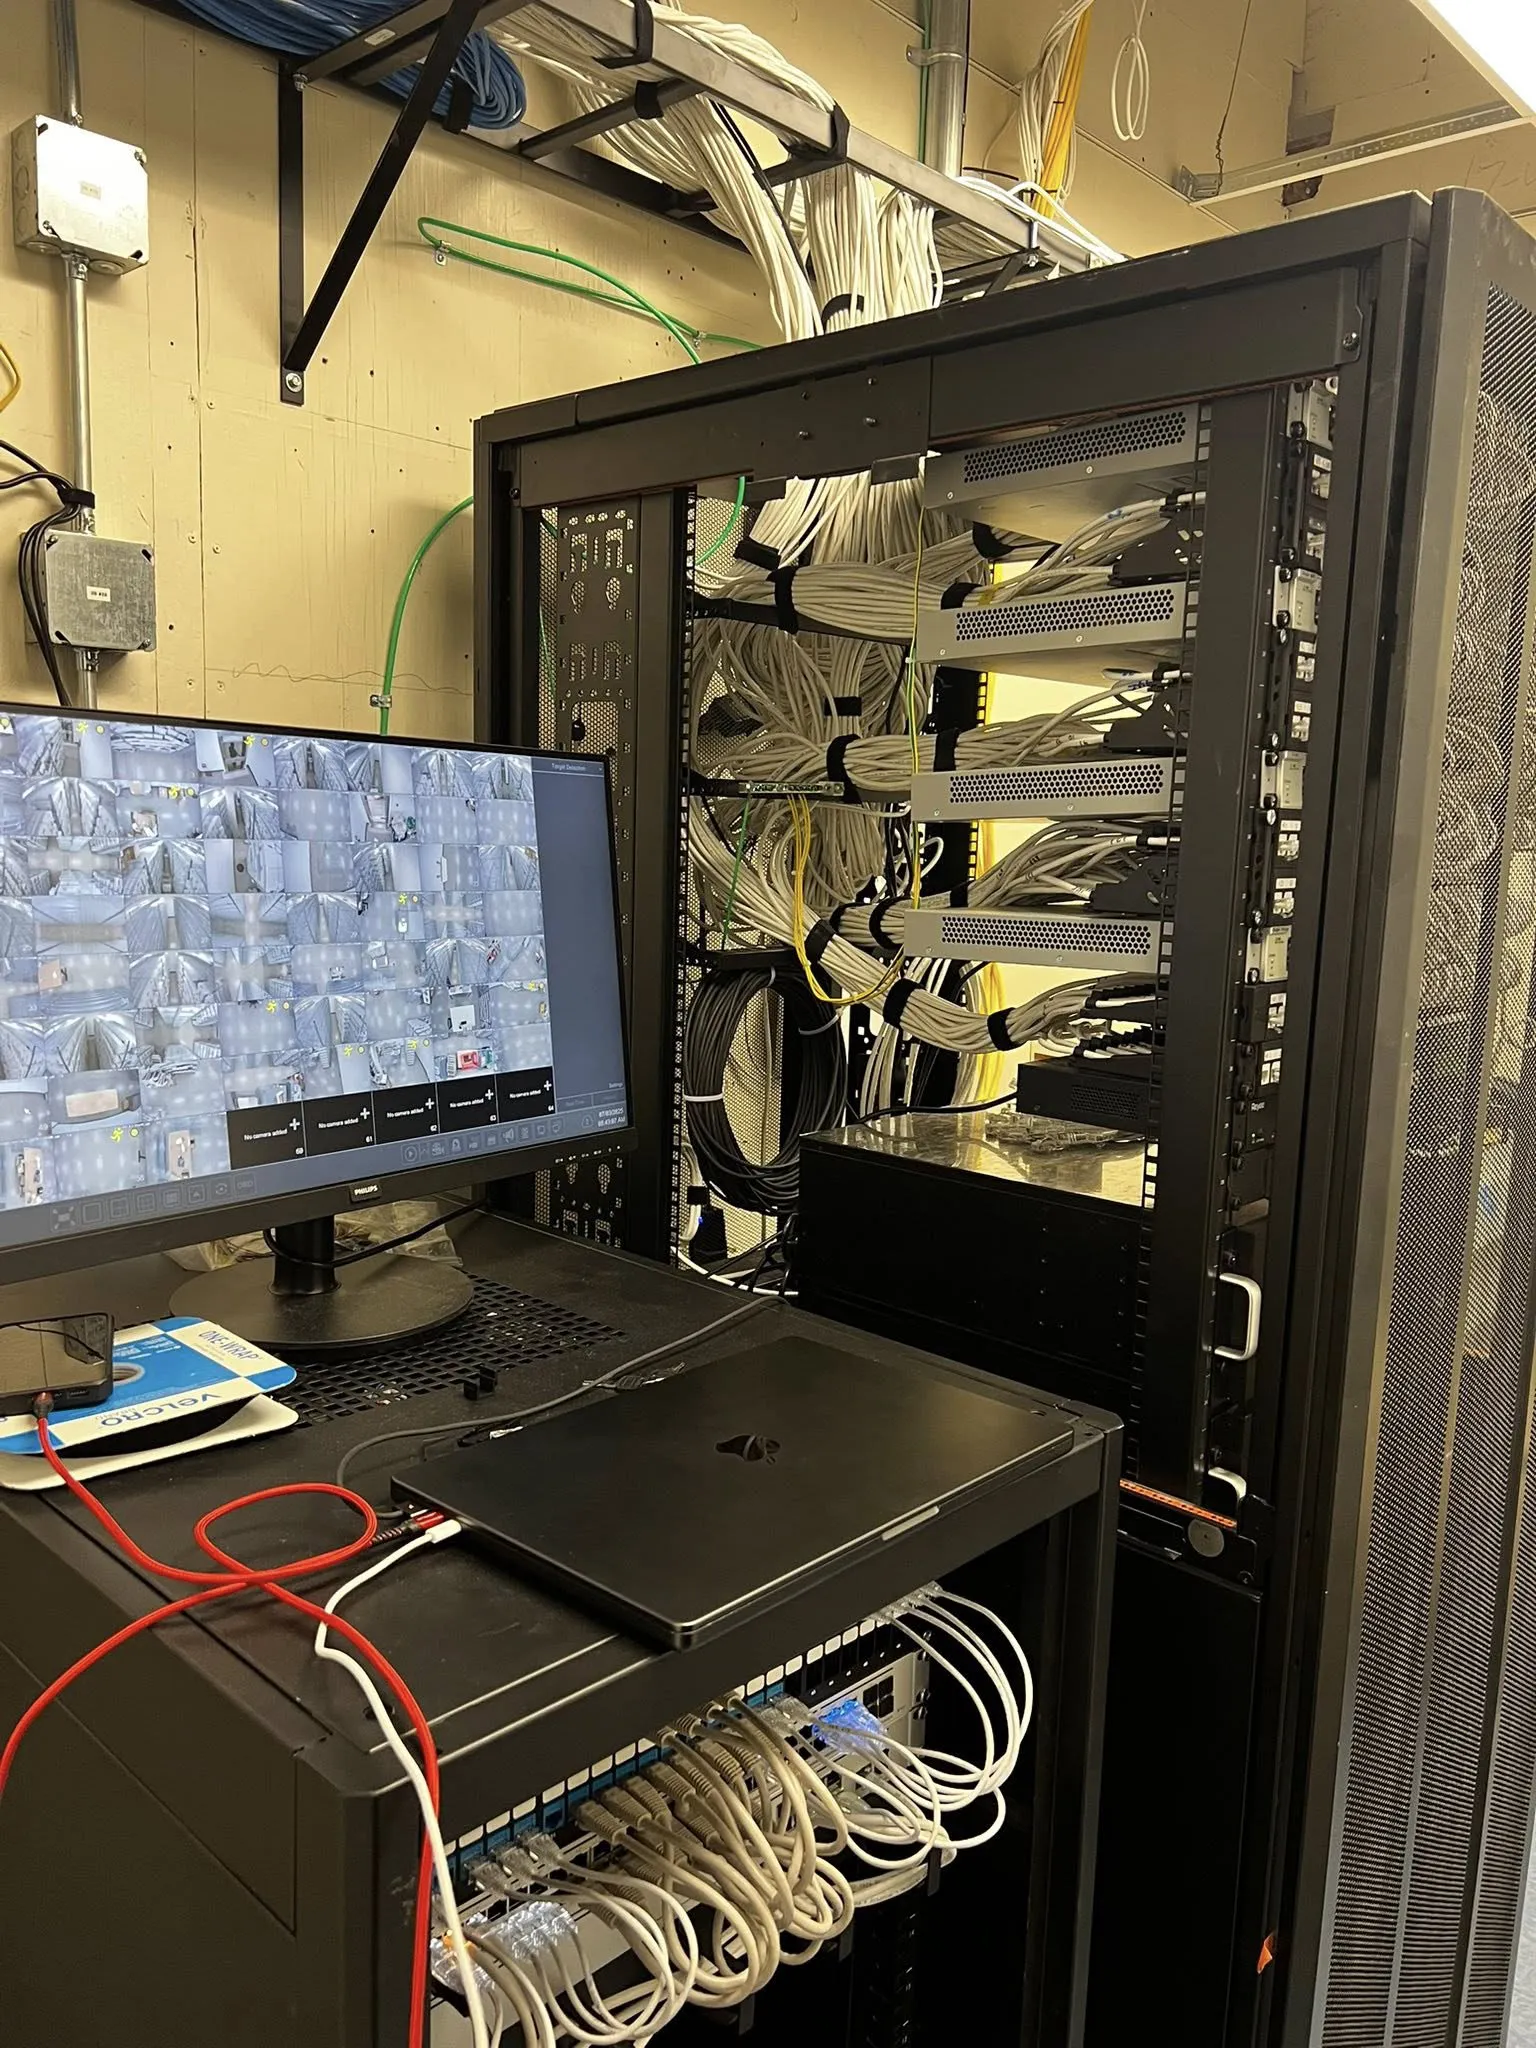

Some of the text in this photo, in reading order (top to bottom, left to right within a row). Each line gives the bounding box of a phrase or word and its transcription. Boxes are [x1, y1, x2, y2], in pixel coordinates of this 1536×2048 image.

[326, 1120, 344, 1128] camera
[344, 1117, 359, 1125] added
[252, 1131, 272, 1139] camera
[271, 1128, 288, 1136] added
[354, 1184, 379, 1196] PHILIPS
